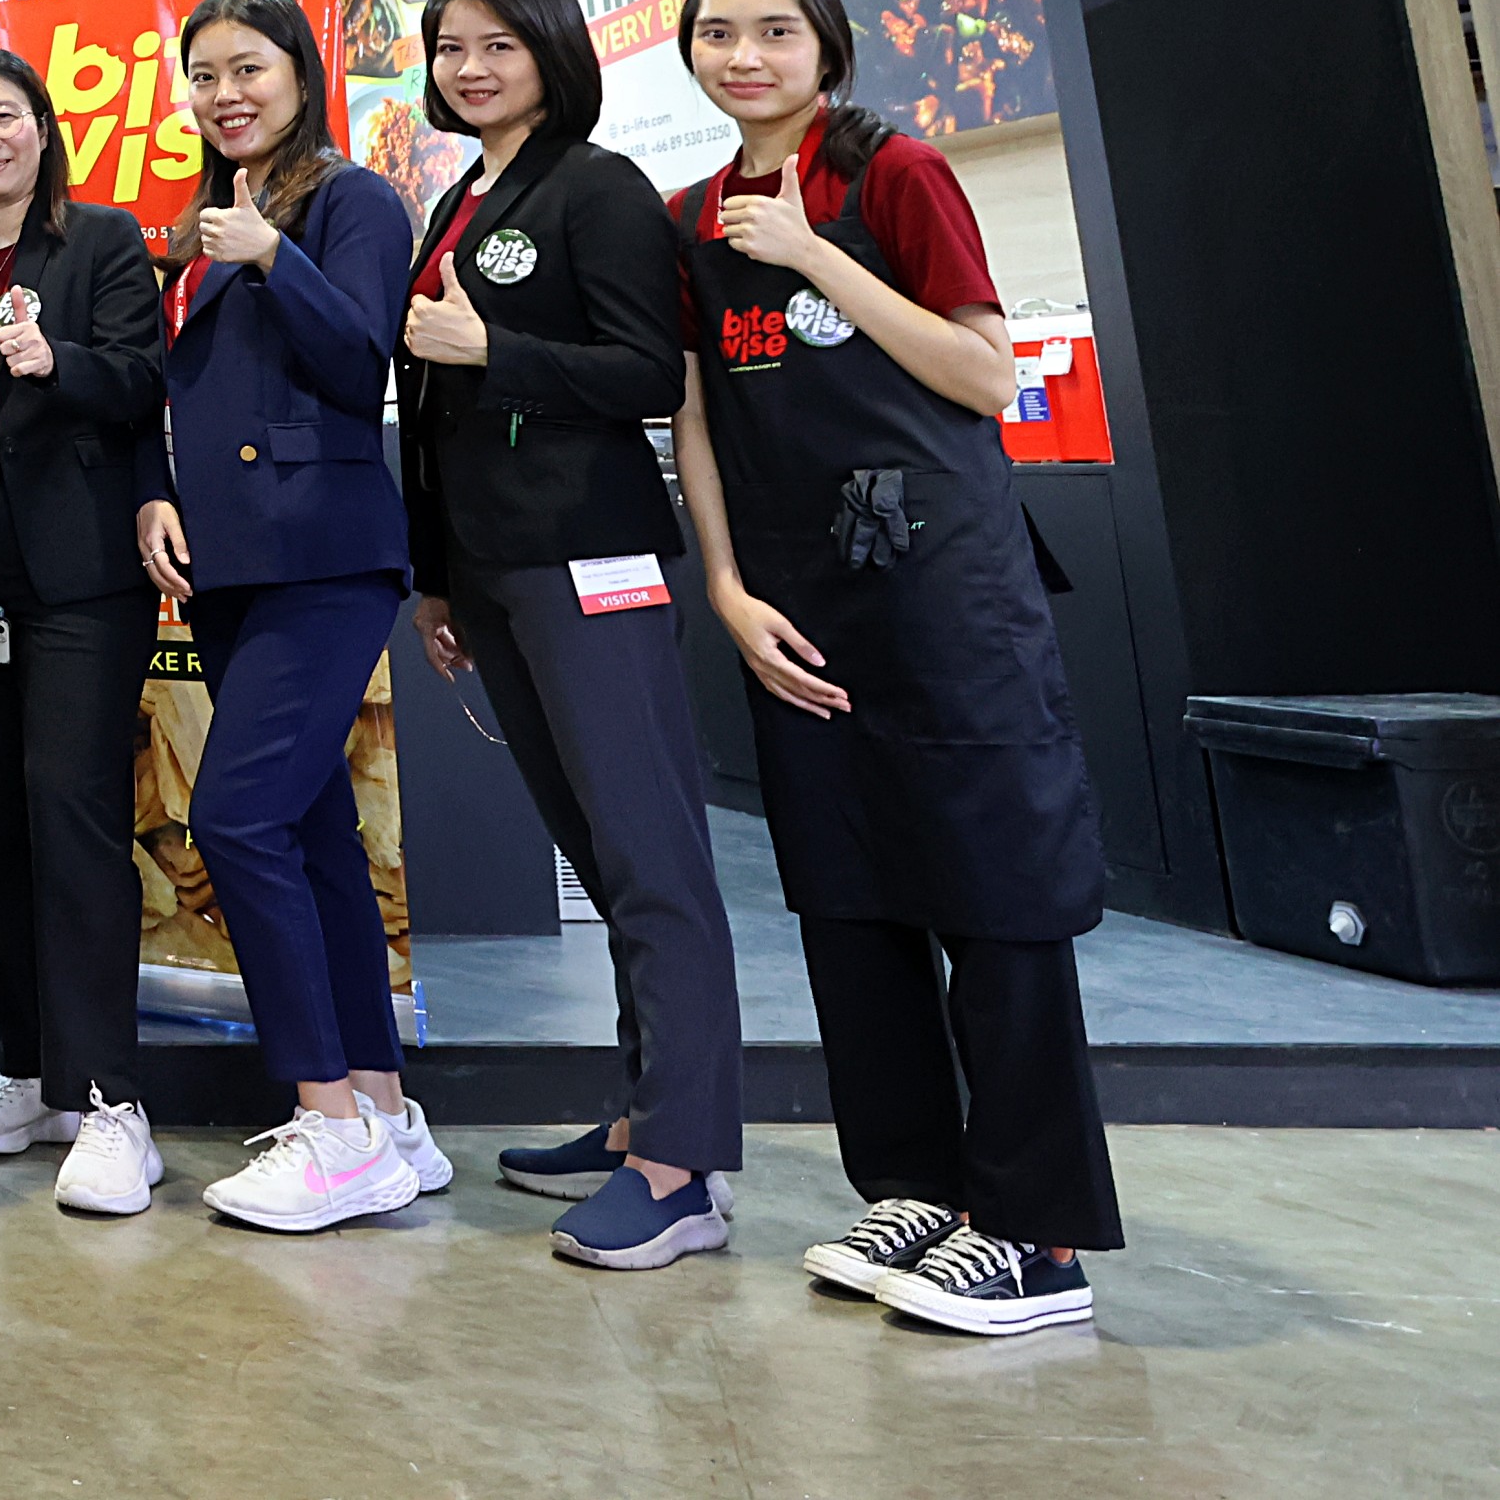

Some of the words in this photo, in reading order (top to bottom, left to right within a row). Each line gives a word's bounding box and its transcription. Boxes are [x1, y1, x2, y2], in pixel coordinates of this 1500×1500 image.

[590, 6, 653, 59] VERY
[397, 40, 420, 63] TAS
[46, 15, 190, 129] bit
[622, 113, 673, 135] zi-life.com
[670, 135, 682, 150] 89
[684, 130, 703, 147] 530
[705, 123, 731, 142] 3250
[484, 234, 538, 262] bite
[476, 251, 534, 277] wise
[722, 304, 785, 341] bite
[785, 313, 855, 338] wise
[719, 333, 788, 364] wise
[598, 590, 651, 607] VISITOR
